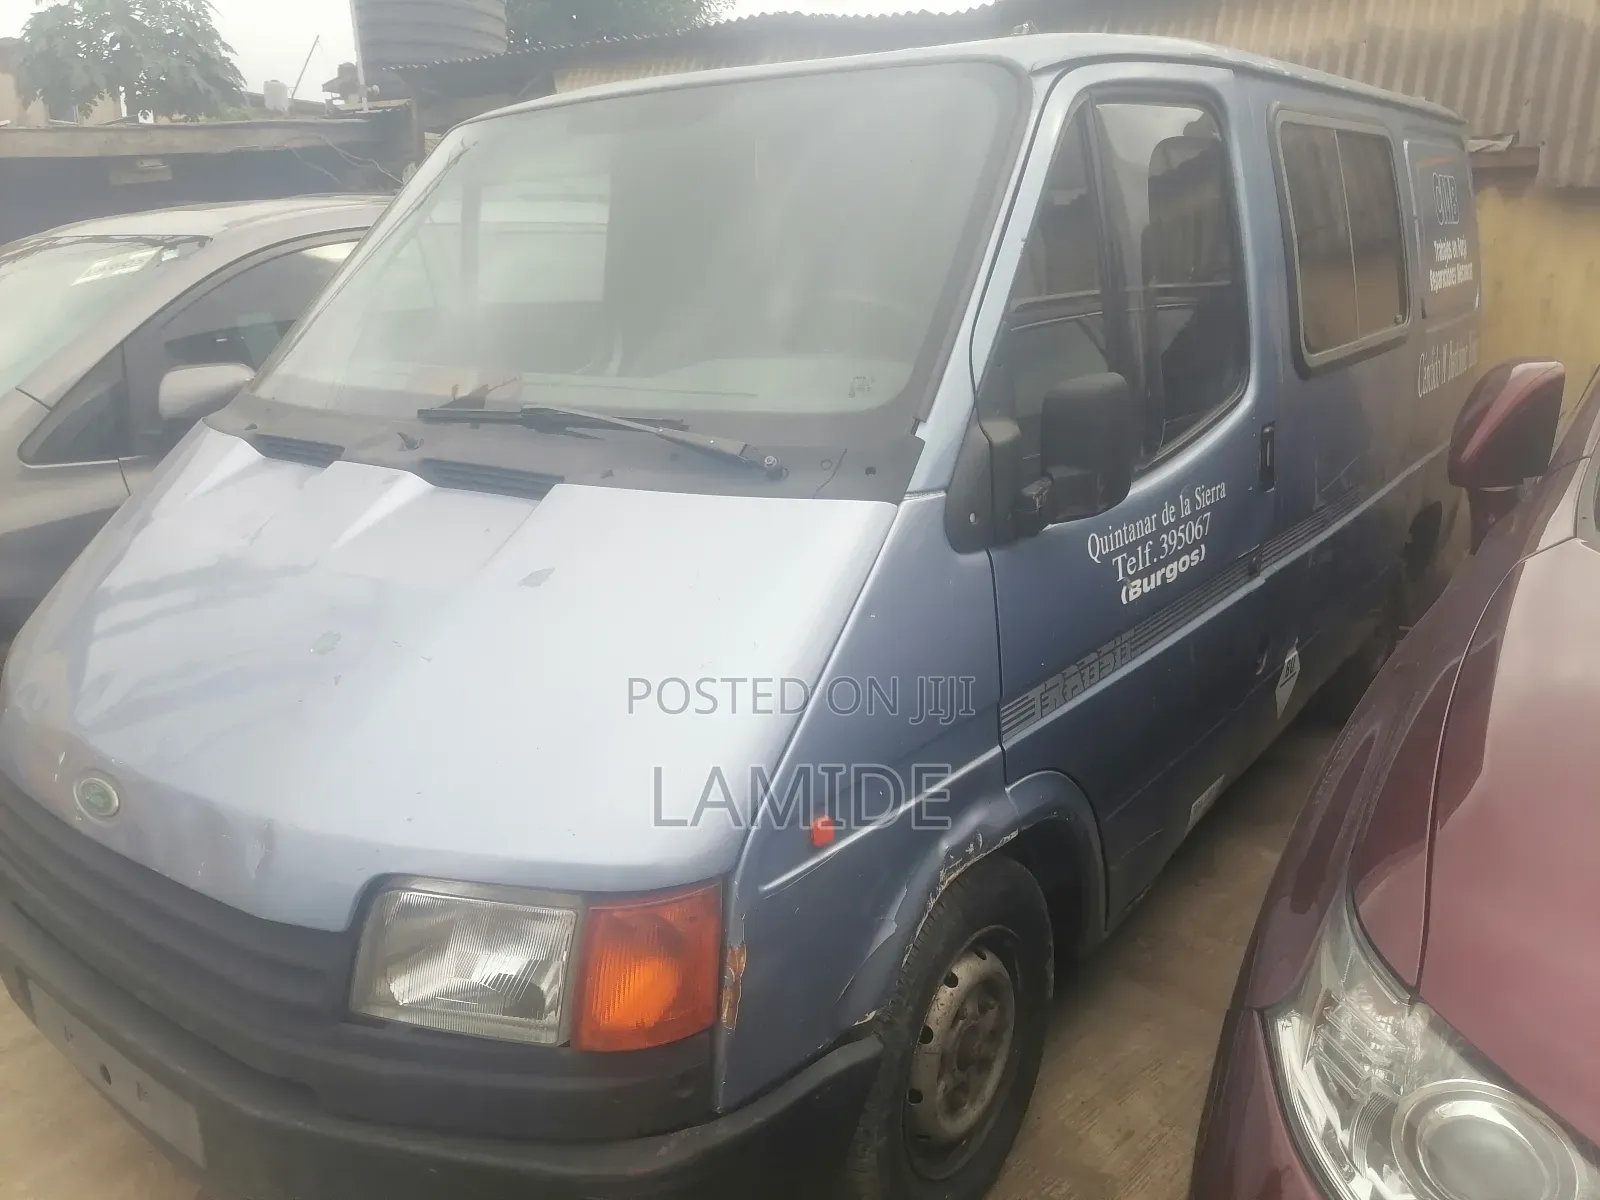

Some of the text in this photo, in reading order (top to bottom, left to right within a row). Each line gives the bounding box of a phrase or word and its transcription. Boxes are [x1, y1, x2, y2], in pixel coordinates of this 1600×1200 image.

[1087, 481, 1226, 564] Quintanar de la Sierra
[1112, 511, 1211, 582] Telf. 395067
[1120, 543, 1206, 605] (Burgos)
